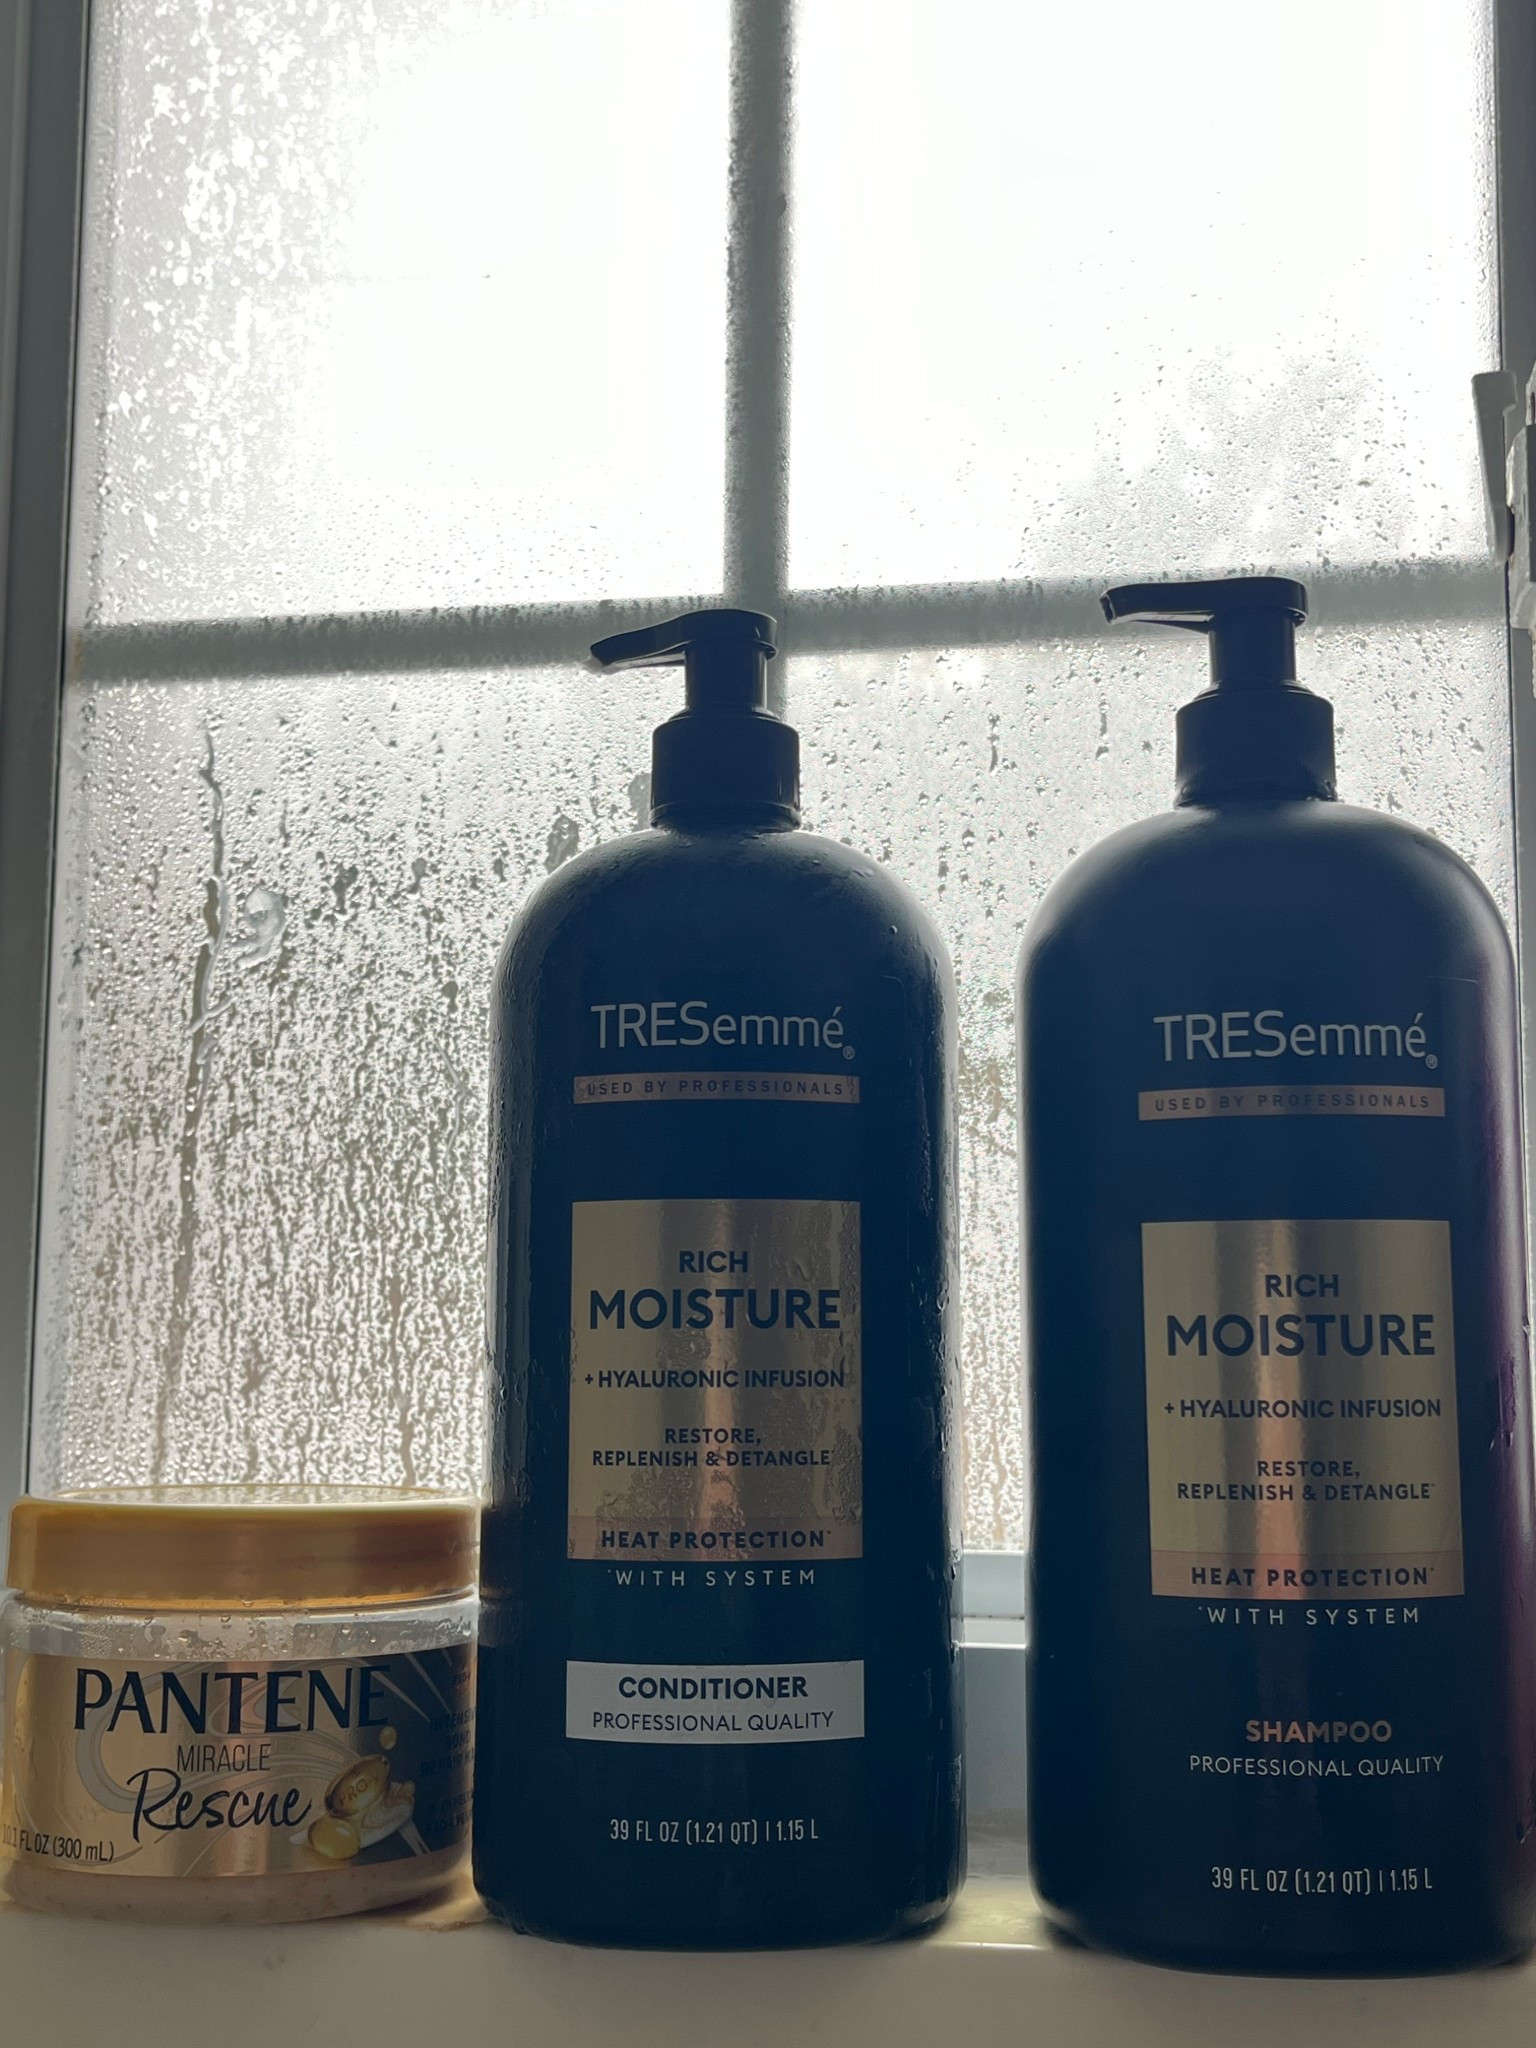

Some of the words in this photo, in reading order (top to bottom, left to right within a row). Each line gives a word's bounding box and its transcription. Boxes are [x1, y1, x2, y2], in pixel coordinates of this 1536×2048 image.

[587, 1082, 633, 1096] USED
[644, 1080, 667, 1093] BY
[679, 1080, 844, 1095] PROFESSIONALS
[1155, 1097, 1206, 1112] USED
[1220, 1096, 1244, 1108] BY
[1257, 1094, 1430, 1109] PROFESSIONALS
[679, 1251, 748, 1273] RICH
[1265, 1275, 1339, 1298] RICH
[590, 1289, 841, 1330] MOISTURE
[1166, 1314, 1435, 1357] MOISTURE
[598, 1370, 739, 1388] HYALURONIC
[744, 1370, 845, 1388] INFUSION
[1181, 1399, 1333, 1418] HYALURONIC
[1341, 1399, 1441, 1418] INFUSION
[665, 1428, 762, 1446] RESTORE,
[593, 1450, 697, 1467] REPLENISH
[706, 1450, 720, 1466] &
[1257, 1461, 1360, 1479] RESTORE,
[1177, 1483, 1293, 1501] REPLENISH
[1303, 1484, 1316, 1500] &
[602, 1530, 659, 1548] HEAT
[705, 1569, 815, 1586] SYSTEM
[1191, 1567, 1255, 1586] HEAT
[1306, 1607, 1419, 1626] SYSTEM
[618, 1676, 809, 1699] CONDITIONER
[74, 1665, 391, 1735] PANTENE
[593, 1711, 742, 1731] PROFESSIONAL
[748, 1711, 834, 1731] QUALITY
[1245, 1720, 1392, 1743] SHAMPOO
[177, 1743, 272, 1773] MIRACLE
[1189, 1755, 1352, 1776] PROFESSIONAL
[1358, 1755, 1443, 1776] QUALITY
[127, 1768, 311, 1843] Rescue
[610, 1819, 629, 1840] 39
[636, 1820, 653, 1842] FL
[660, 1821, 680, 1843] OZ
[686, 1820, 723, 1845] (1.21
[730, 1819, 758, 1845] QT)
[776, 1819, 804, 1841] 1.15
[810, 1819, 819, 1839] L
[19, 1830, 31, 1852] FL
[34, 1833, 50, 1854] OZ
[53, 1836, 82, 1859] (300
[86, 1841, 114, 1862] mL)
[1212, 1867, 1232, 1889] 39
[1240, 1868, 1259, 1891] FL
[1266, 1869, 1288, 1892] OZ
[1295, 1868, 1335, 1895] (1.21
[1342, 1868, 1371, 1895] QT)
[1390, 1868, 1417, 1891] 1.15
[1424, 1867, 1432, 1889] L
